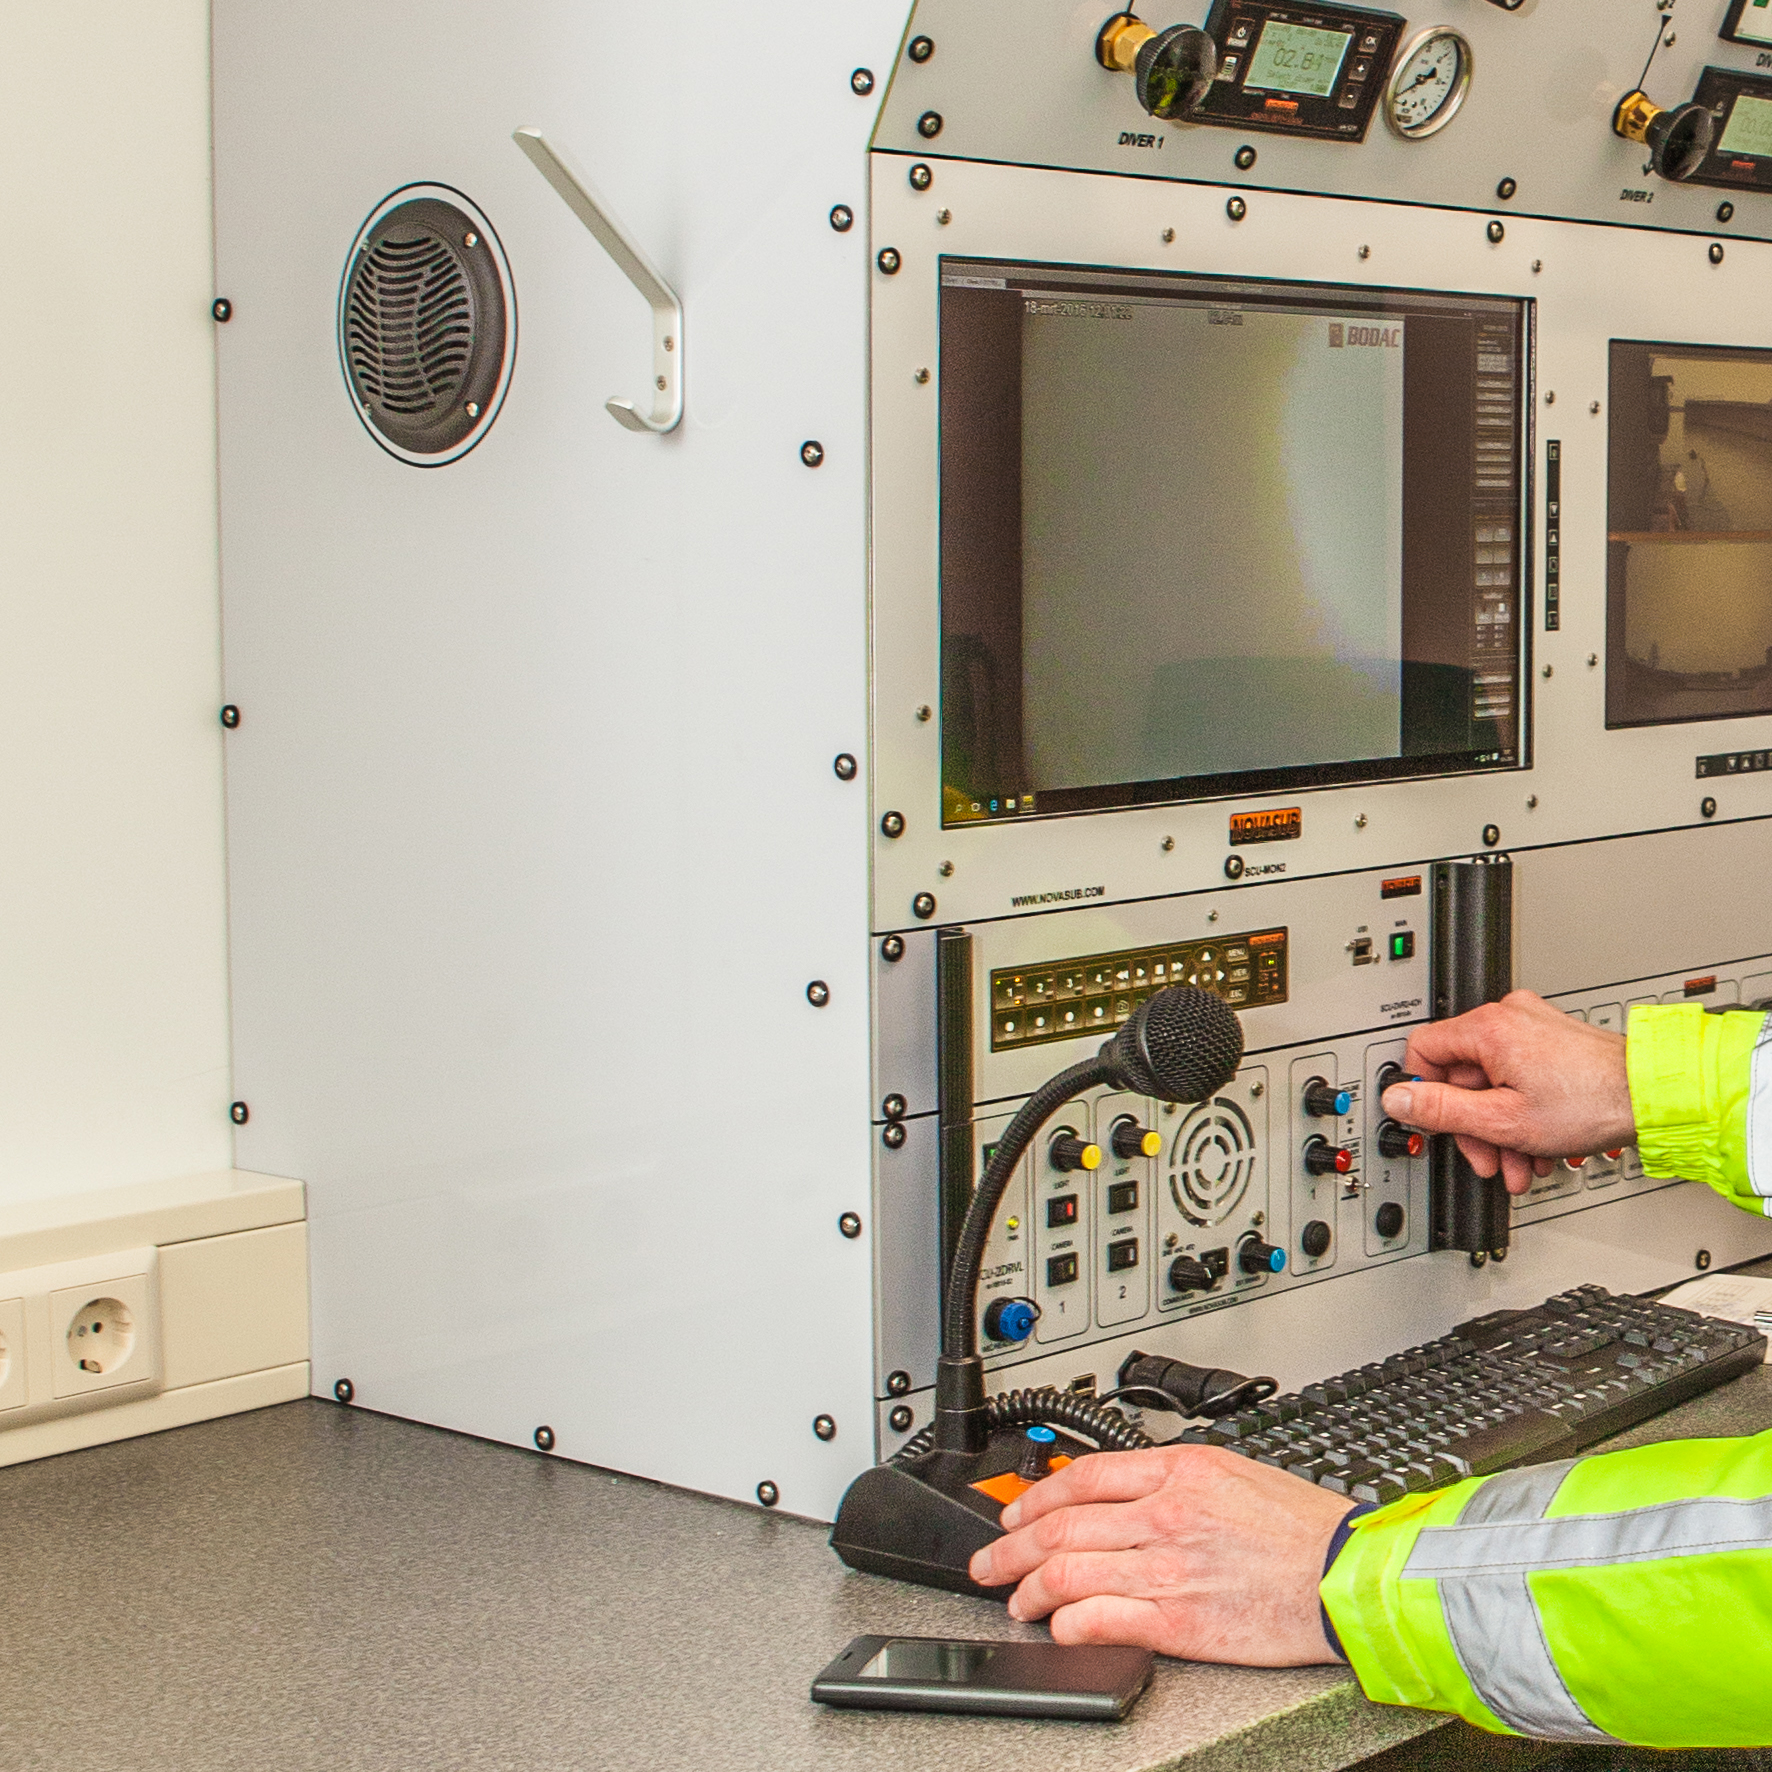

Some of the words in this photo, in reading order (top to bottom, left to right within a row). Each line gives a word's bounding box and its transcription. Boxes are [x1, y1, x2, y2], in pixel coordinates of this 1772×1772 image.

[1117, 131, 1156, 149] DIVER
[1157, 136, 1165, 149] 1
[1619, 188, 1646, 203] DIVER
[1347, 325, 1401, 348] BODAC
[1232, 810, 1300, 841] NOVASUB
[1011, 885, 1105, 908] WWW.NOVASUB.COM
[1384, 1169, 1391, 1183] 2
[1118, 1284, 1127, 1300] 2
[1058, 1300, 1067, 1315] 1
